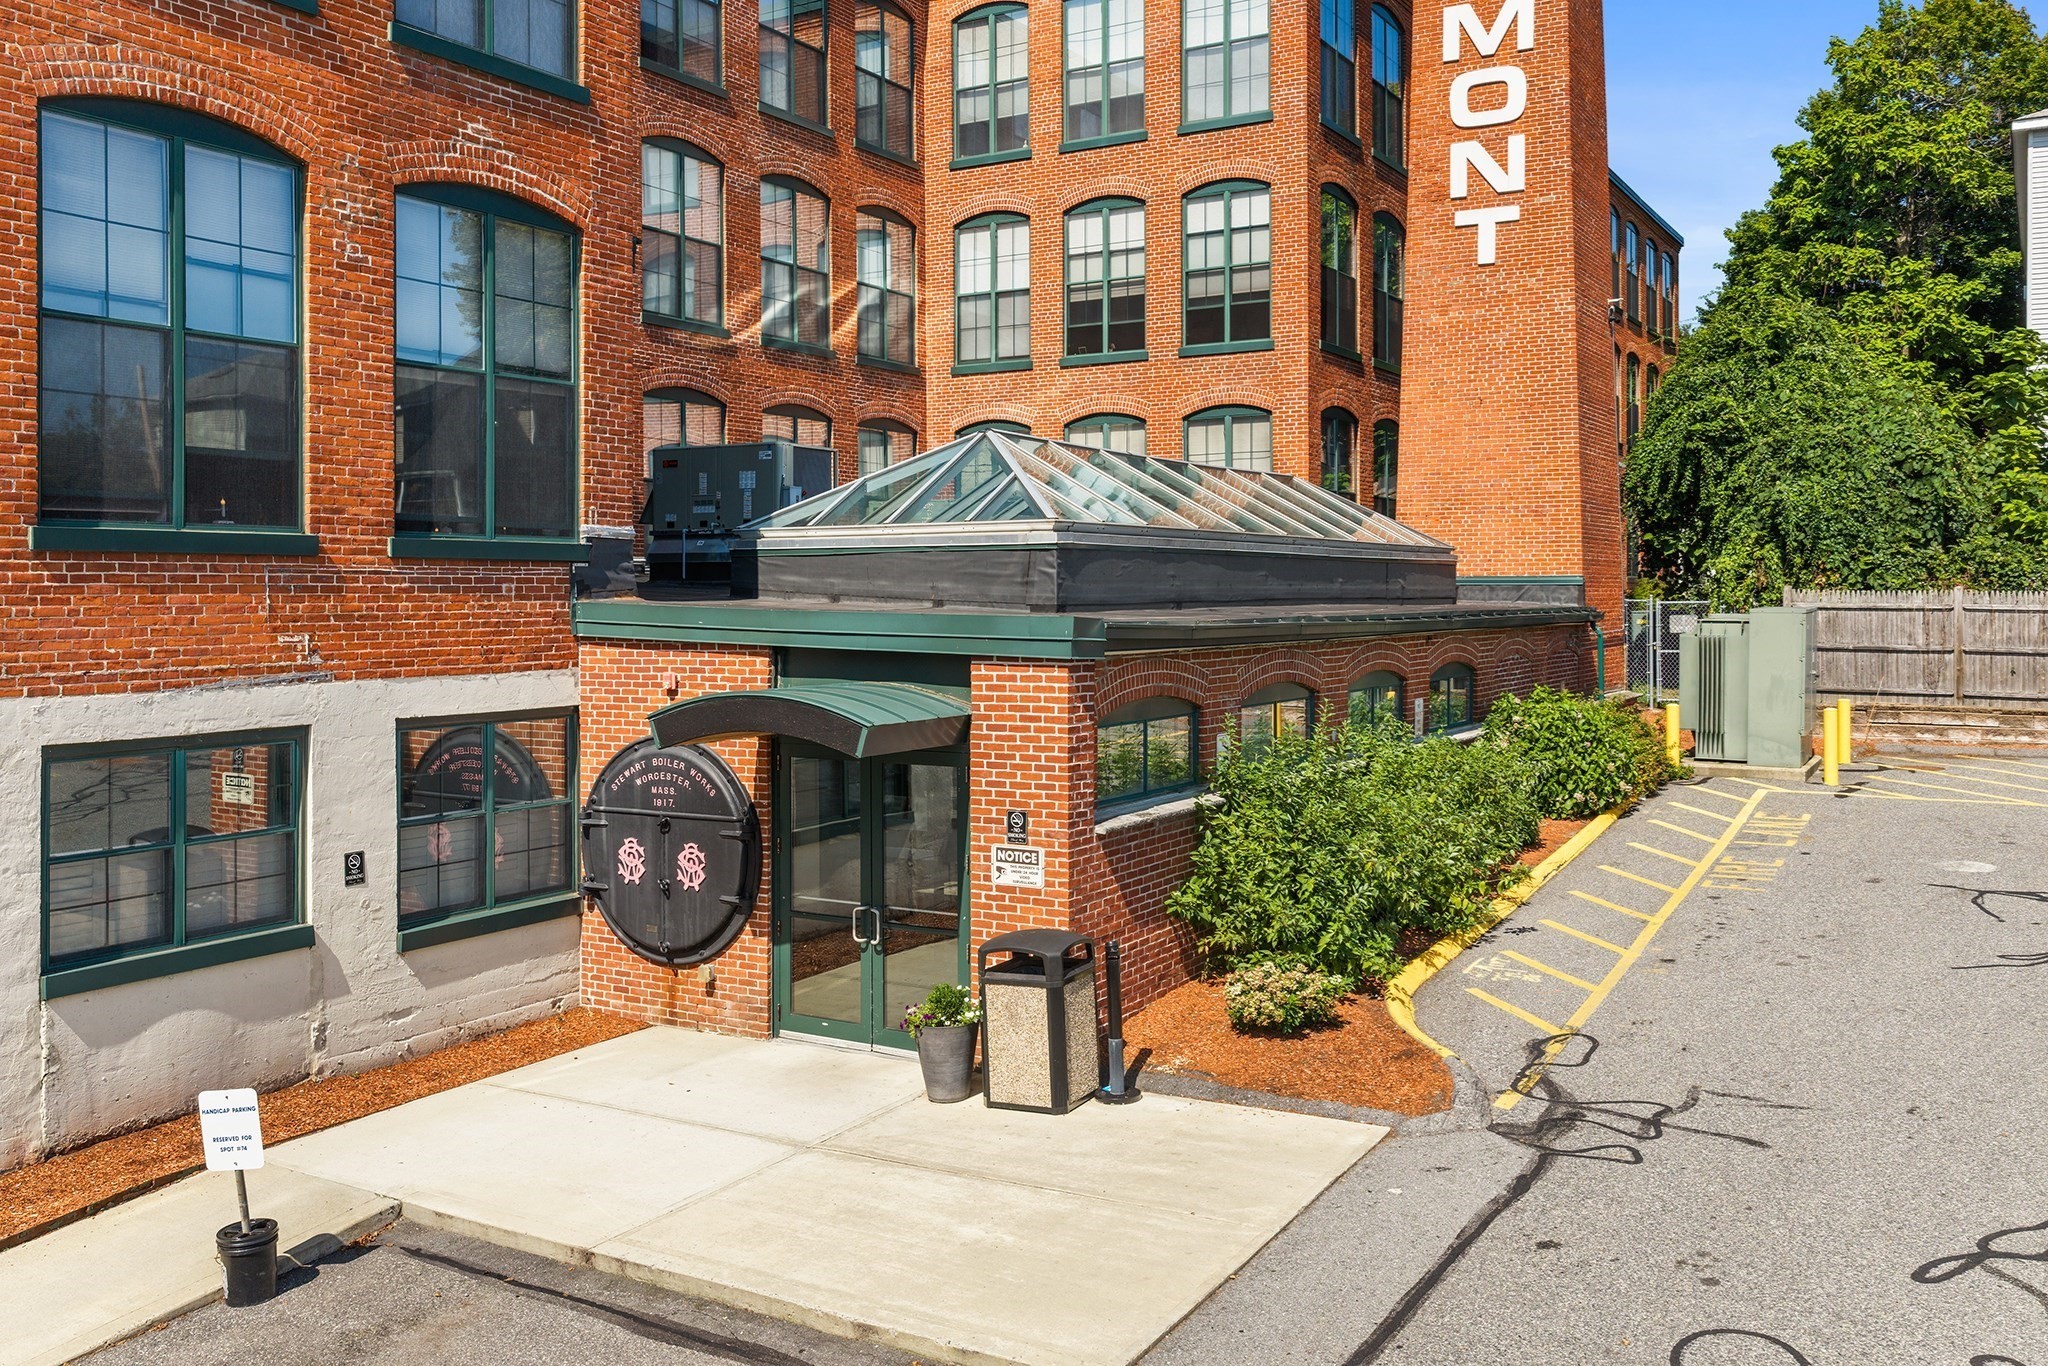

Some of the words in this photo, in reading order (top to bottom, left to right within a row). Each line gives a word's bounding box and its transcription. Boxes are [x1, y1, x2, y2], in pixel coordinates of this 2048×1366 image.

[1443, 0, 1534, 265] MONT
[611, 760, 646, 791] STEWART
[652, 757, 686, 771] BOILER
[689, 767, 716, 797] WORKS
[634, 772, 692, 790] WORCESTER.
[651, 786, 677, 795] MASS.
[997, 849, 1038, 864] NOTICE
[202, 1107, 230, 1115] HANDICAP
[212, 1135, 239, 1143] RESERVED
